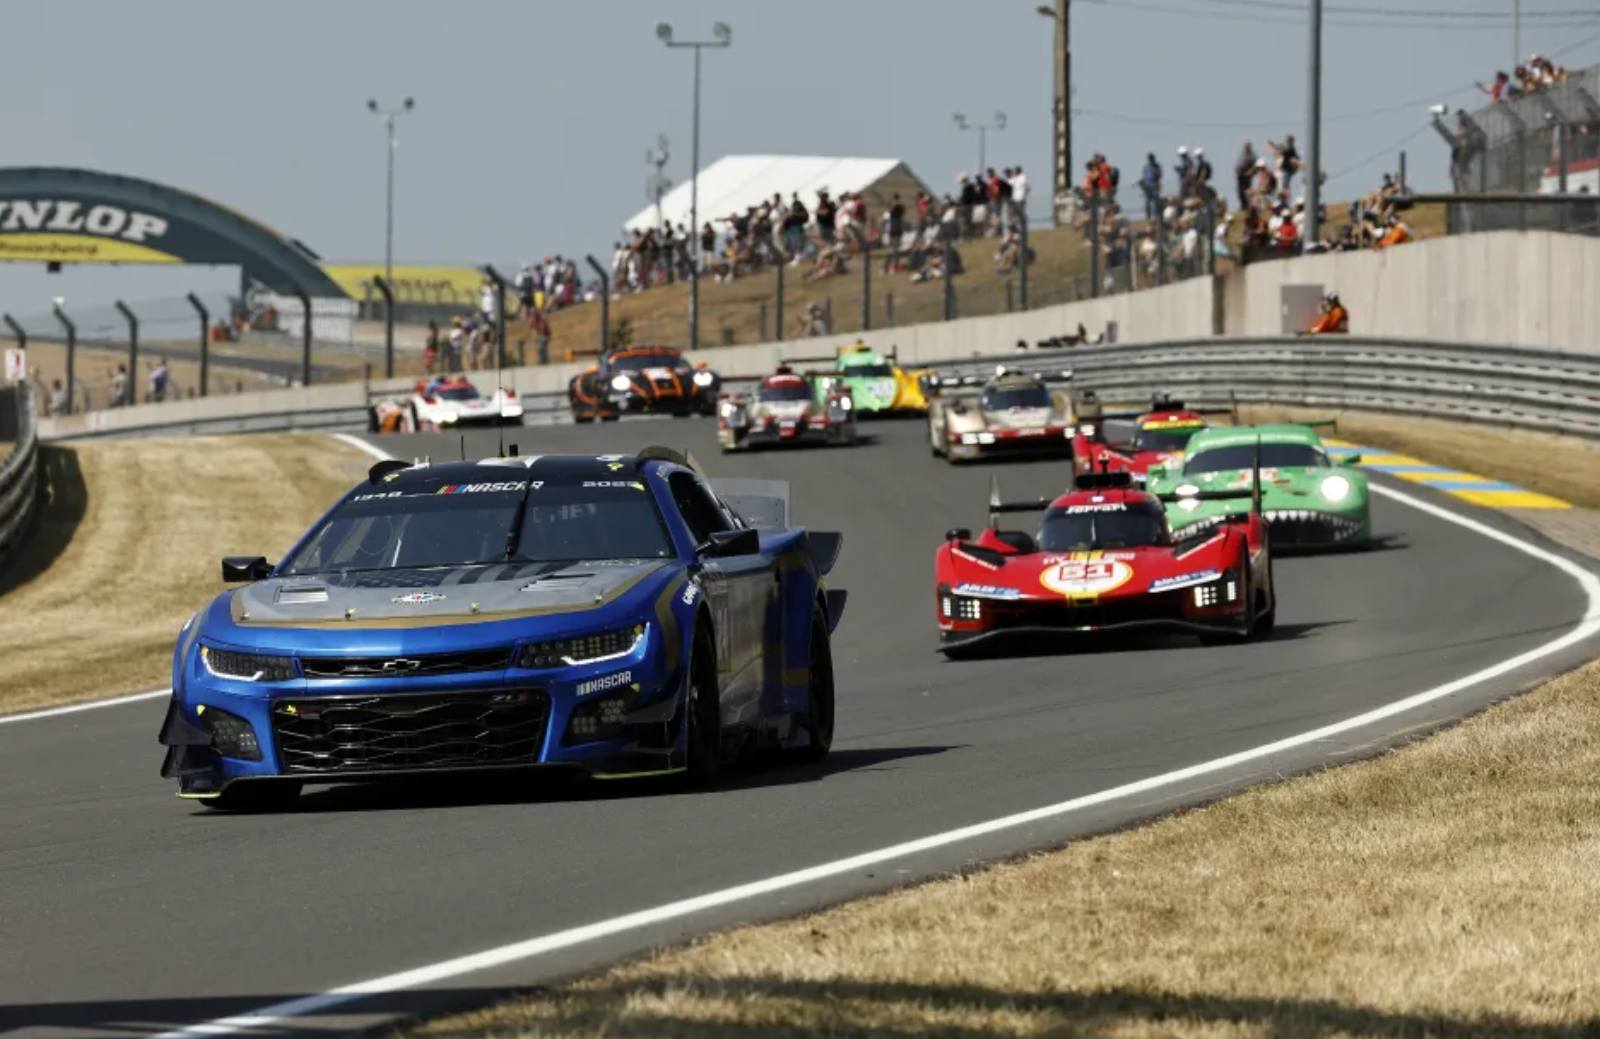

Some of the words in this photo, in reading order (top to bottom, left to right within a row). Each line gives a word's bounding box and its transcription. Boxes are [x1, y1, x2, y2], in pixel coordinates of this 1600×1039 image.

[463, 480, 544, 494] NASCAR
[1060, 563, 1113, 581] 51
[589, 671, 632, 694] NASCAR
